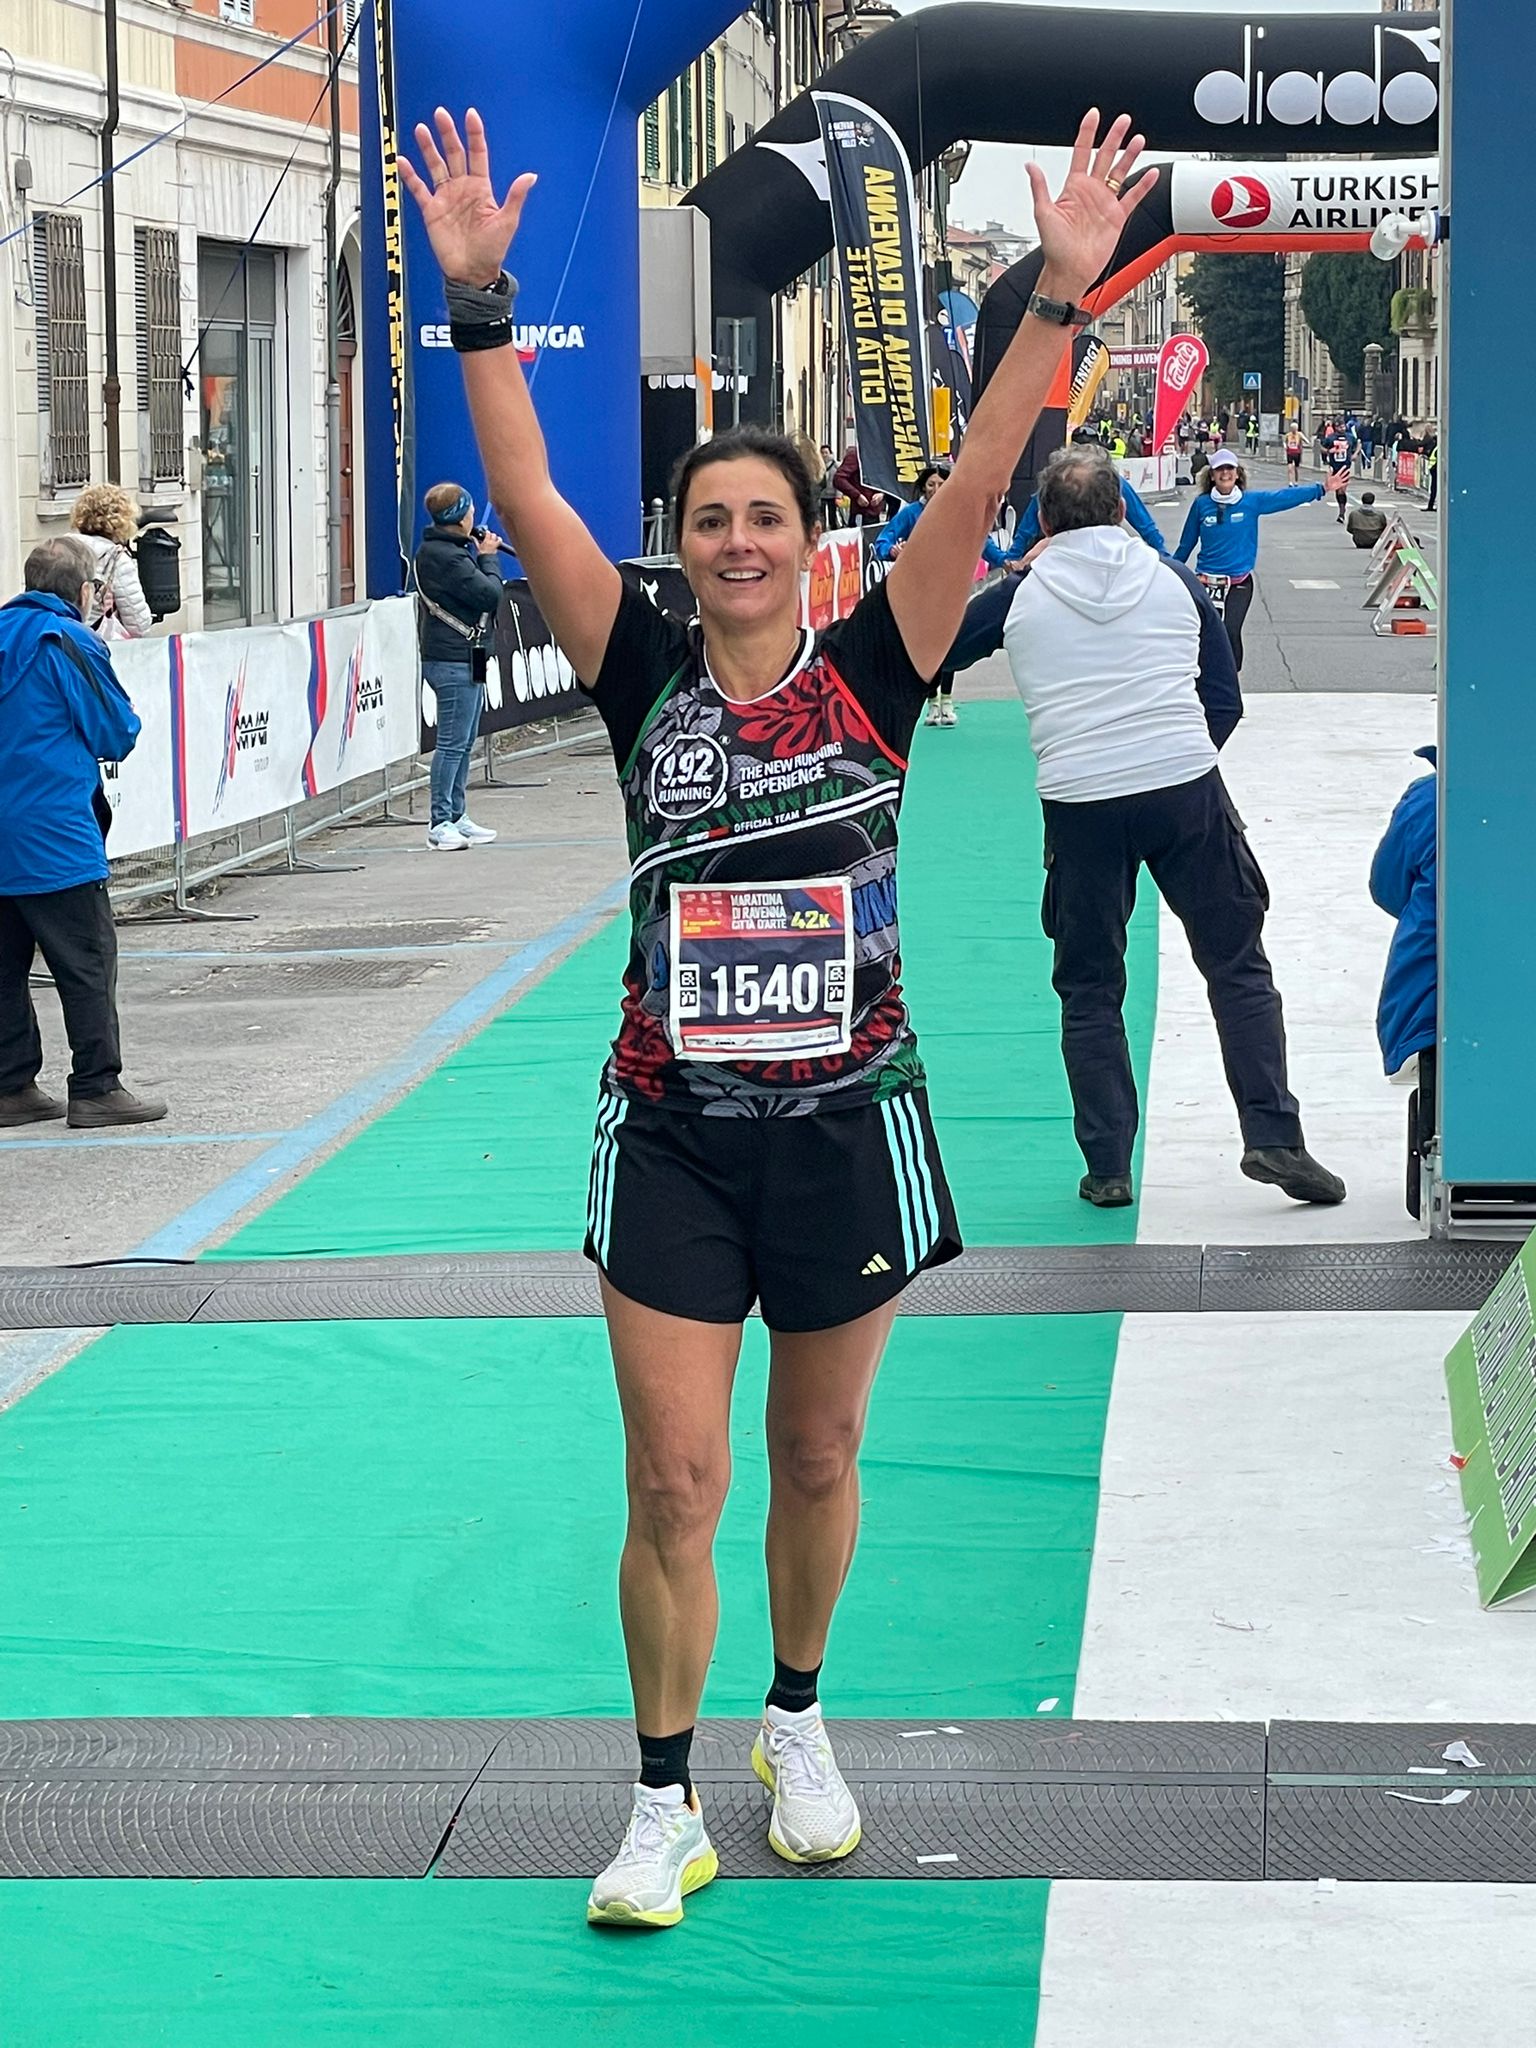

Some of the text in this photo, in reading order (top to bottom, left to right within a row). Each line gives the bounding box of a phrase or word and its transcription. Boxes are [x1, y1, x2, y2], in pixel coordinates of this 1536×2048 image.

[1194, 24, 1438, 126] diado
[1290, 175, 1439, 202] TURKISH
[420, 324, 585, 349] ESUNGA
[739, 741, 843, 781] THE NEW RUNNING
[739, 762, 827, 799] EXPERIENCE
[733, 810, 800, 833] OFFICIAL TEAM
[730, 893, 784, 906] MARATONA
[732, 905, 787, 920] DI RAVENNA
[757, 918, 787, 930] D'ARTE
[710, 963, 819, 1017] 1540
